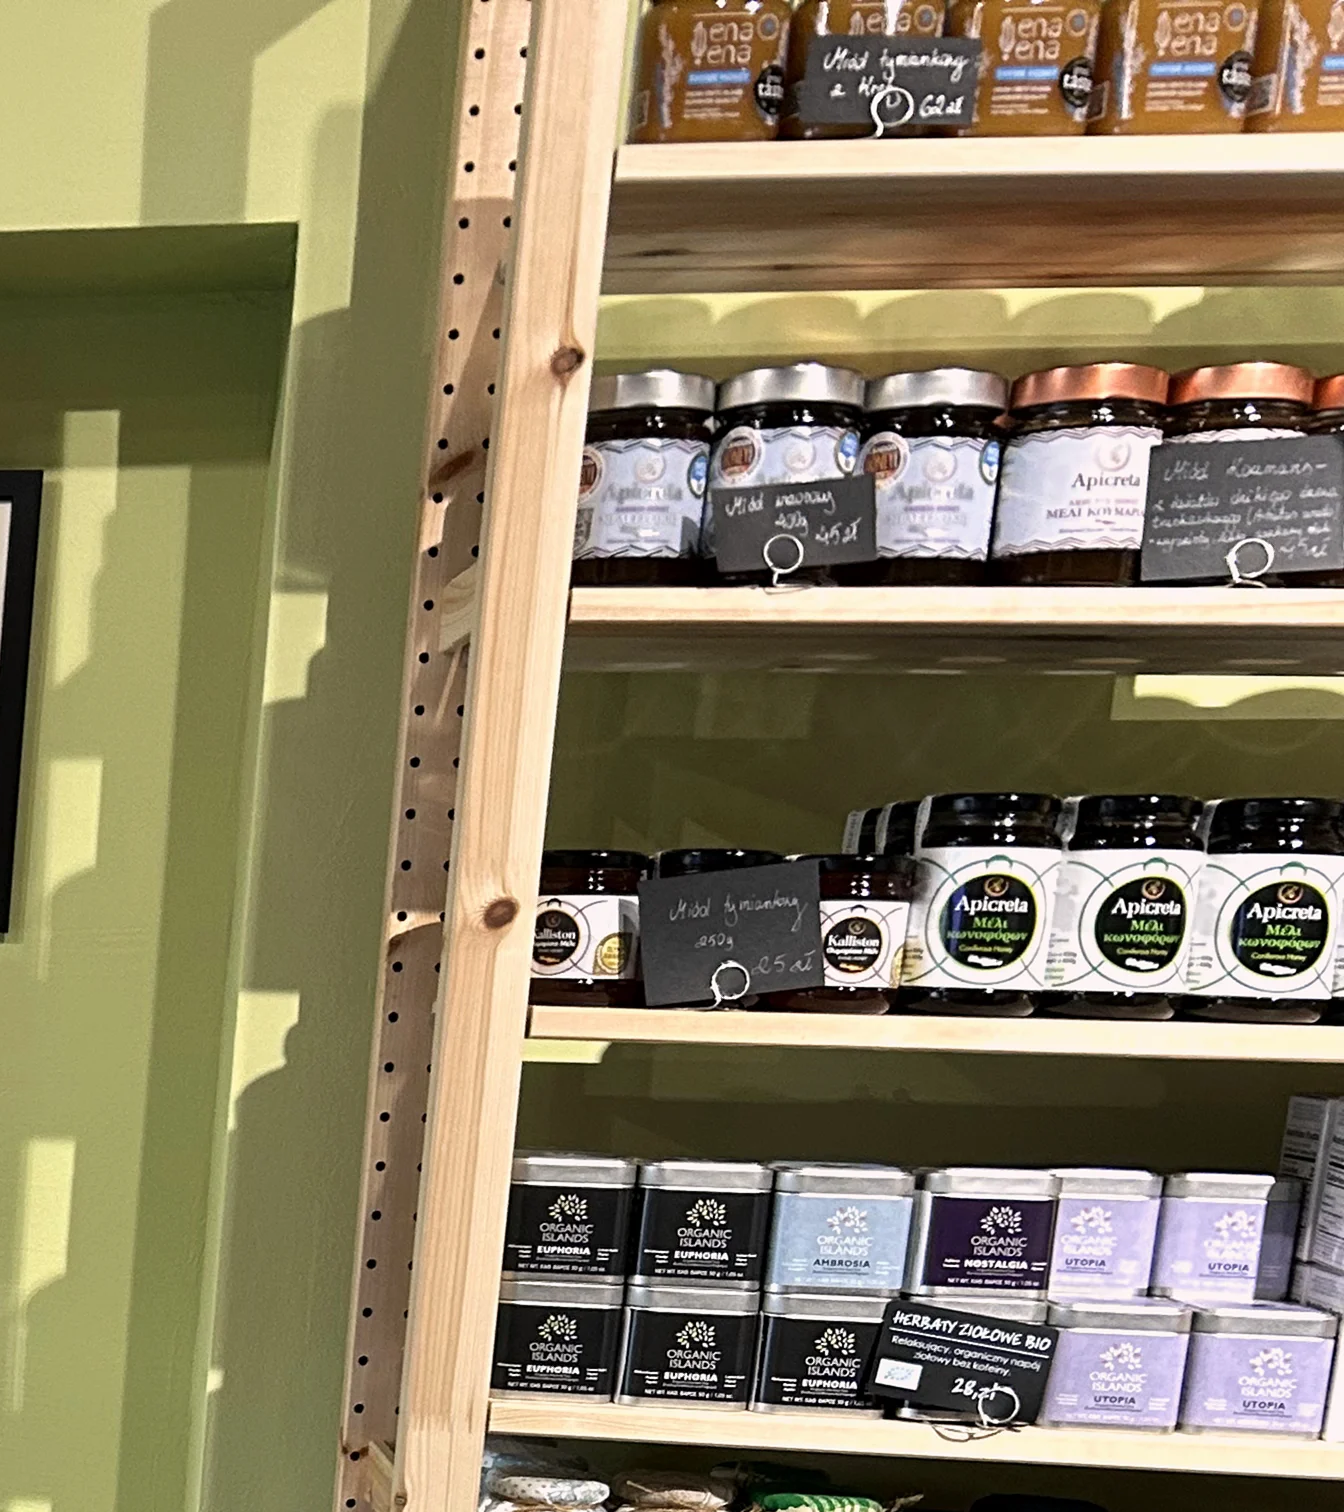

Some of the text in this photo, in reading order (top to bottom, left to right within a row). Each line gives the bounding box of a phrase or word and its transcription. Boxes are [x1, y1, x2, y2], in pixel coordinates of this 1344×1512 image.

[1072, 473, 1141, 491] Apicreta
[955, 895, 1028, 915] Apicreta
[1112, 897, 1181, 918] Apicreta
[1246, 902, 1322, 922] Apicreta
[827, 935, 880, 948] Kalliston
[539, 1222, 593, 1235] ORGANIC
[677, 1227, 732, 1240] ORGANIC
[542, 1232, 589, 1244] ISLANDS
[679, 1237, 727, 1249] ISLANDS
[817, 1234, 873, 1247] ORGANIC
[971, 1234, 1028, 1248] ORGANIC
[537, 1245, 591, 1256] EUPHORIA
[674, 1250, 729, 1262] EUPHORIA
[820, 1244, 869, 1256] ISLANDS
[973, 1245, 1023, 1257] ISLANDS
[813, 1258, 871, 1269] AMBROSIA
[964, 1258, 1028, 1271] NOSTALGIA
[1065, 1257, 1106, 1268] UTOPIA
[1208, 1261, 1250, 1273] UTOPIA
[892, 1311, 1053, 1352] HERBATY ZIOŁOWE BIO
[530, 1341, 583, 1354] ORGANIC
[532, 1351, 578, 1363] ISLANDS
[666, 1349, 721, 1361] ORGANIC
[954, 1346, 1042, 1373] organiczny napój
[669, 1358, 716, 1370] ISLANDS
[805, 1356, 861, 1368] ORGANIC
[952, 1357, 971, 1369] bez
[526, 1364, 580, 1376] EUPHORIA
[807, 1365, 856, 1378] ISLANDS
[664, 1371, 718, 1383] EUPHORIA
[802, 1378, 858, 1390] EUPHORIA
[1093, 1395, 1137, 1406] UTOPIA
[1242, 1399, 1286, 1411] UTOPIA
